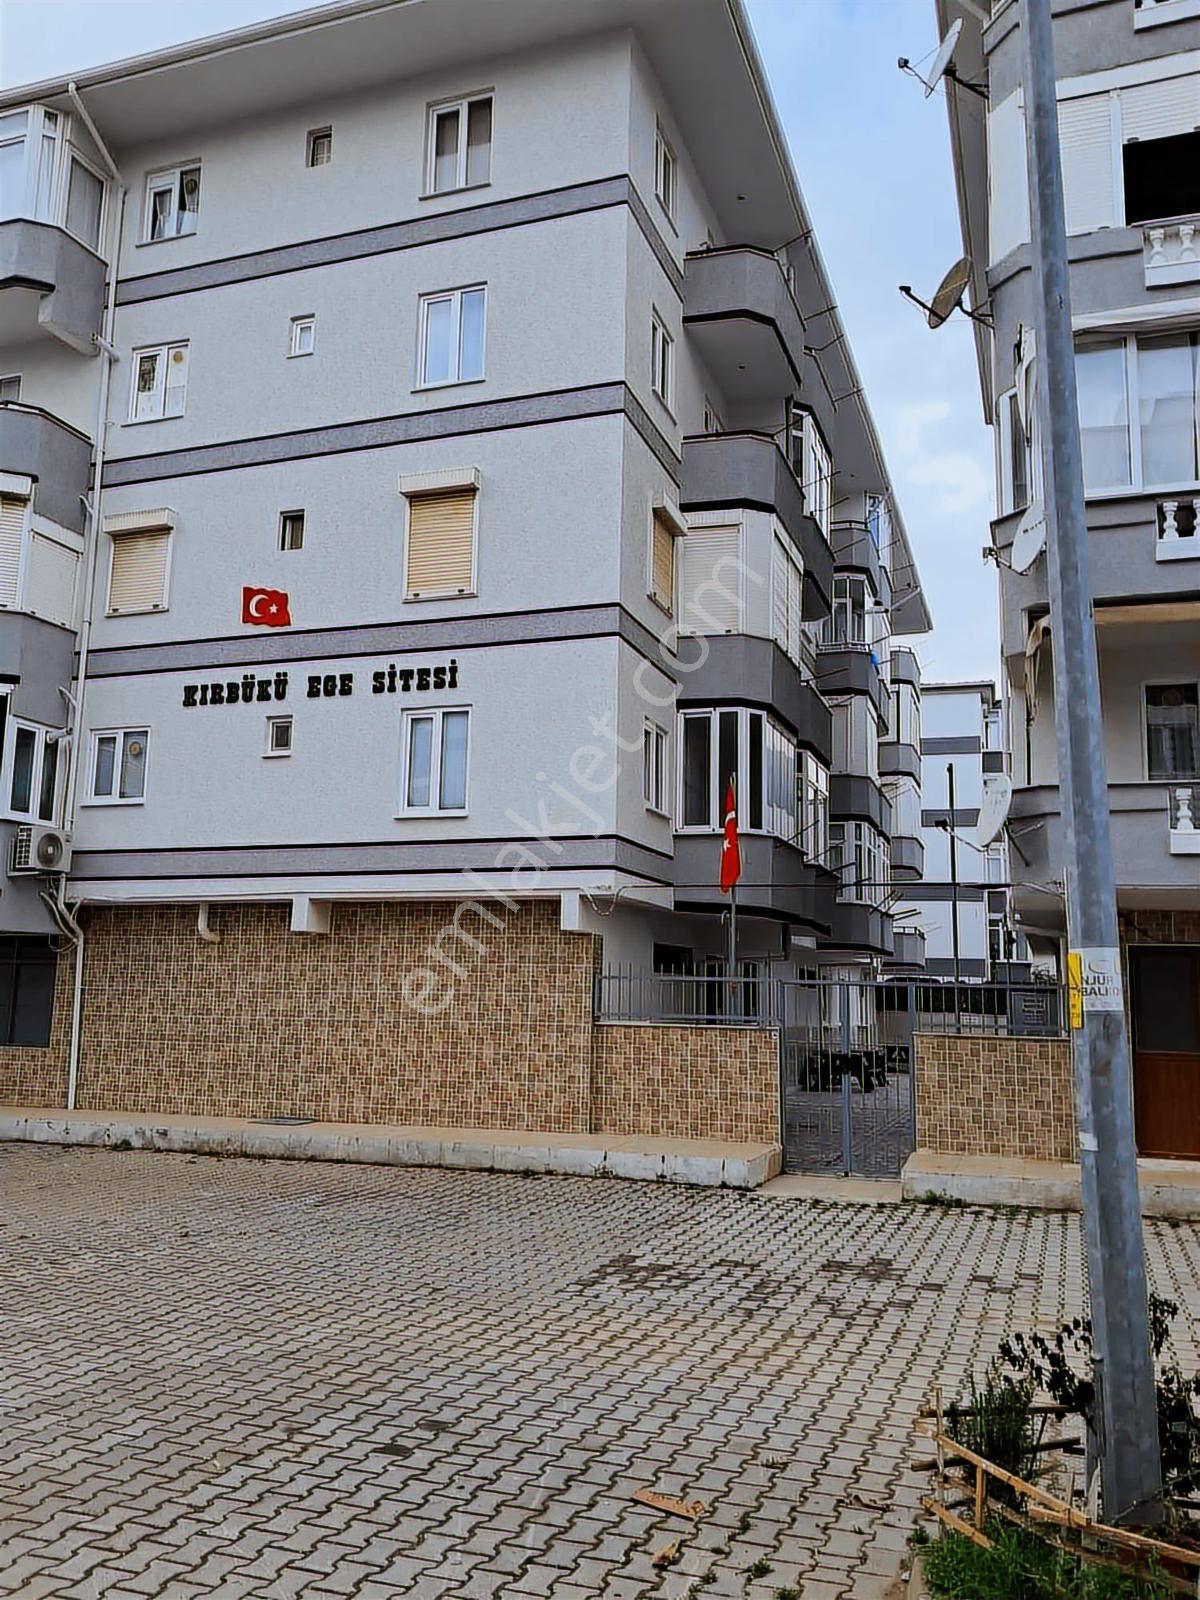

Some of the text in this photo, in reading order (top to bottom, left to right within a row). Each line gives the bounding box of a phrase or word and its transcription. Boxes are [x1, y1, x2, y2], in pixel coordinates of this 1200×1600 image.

[182, 659, 458, 707] KIRBÜKÜ EGE SİTESİ
